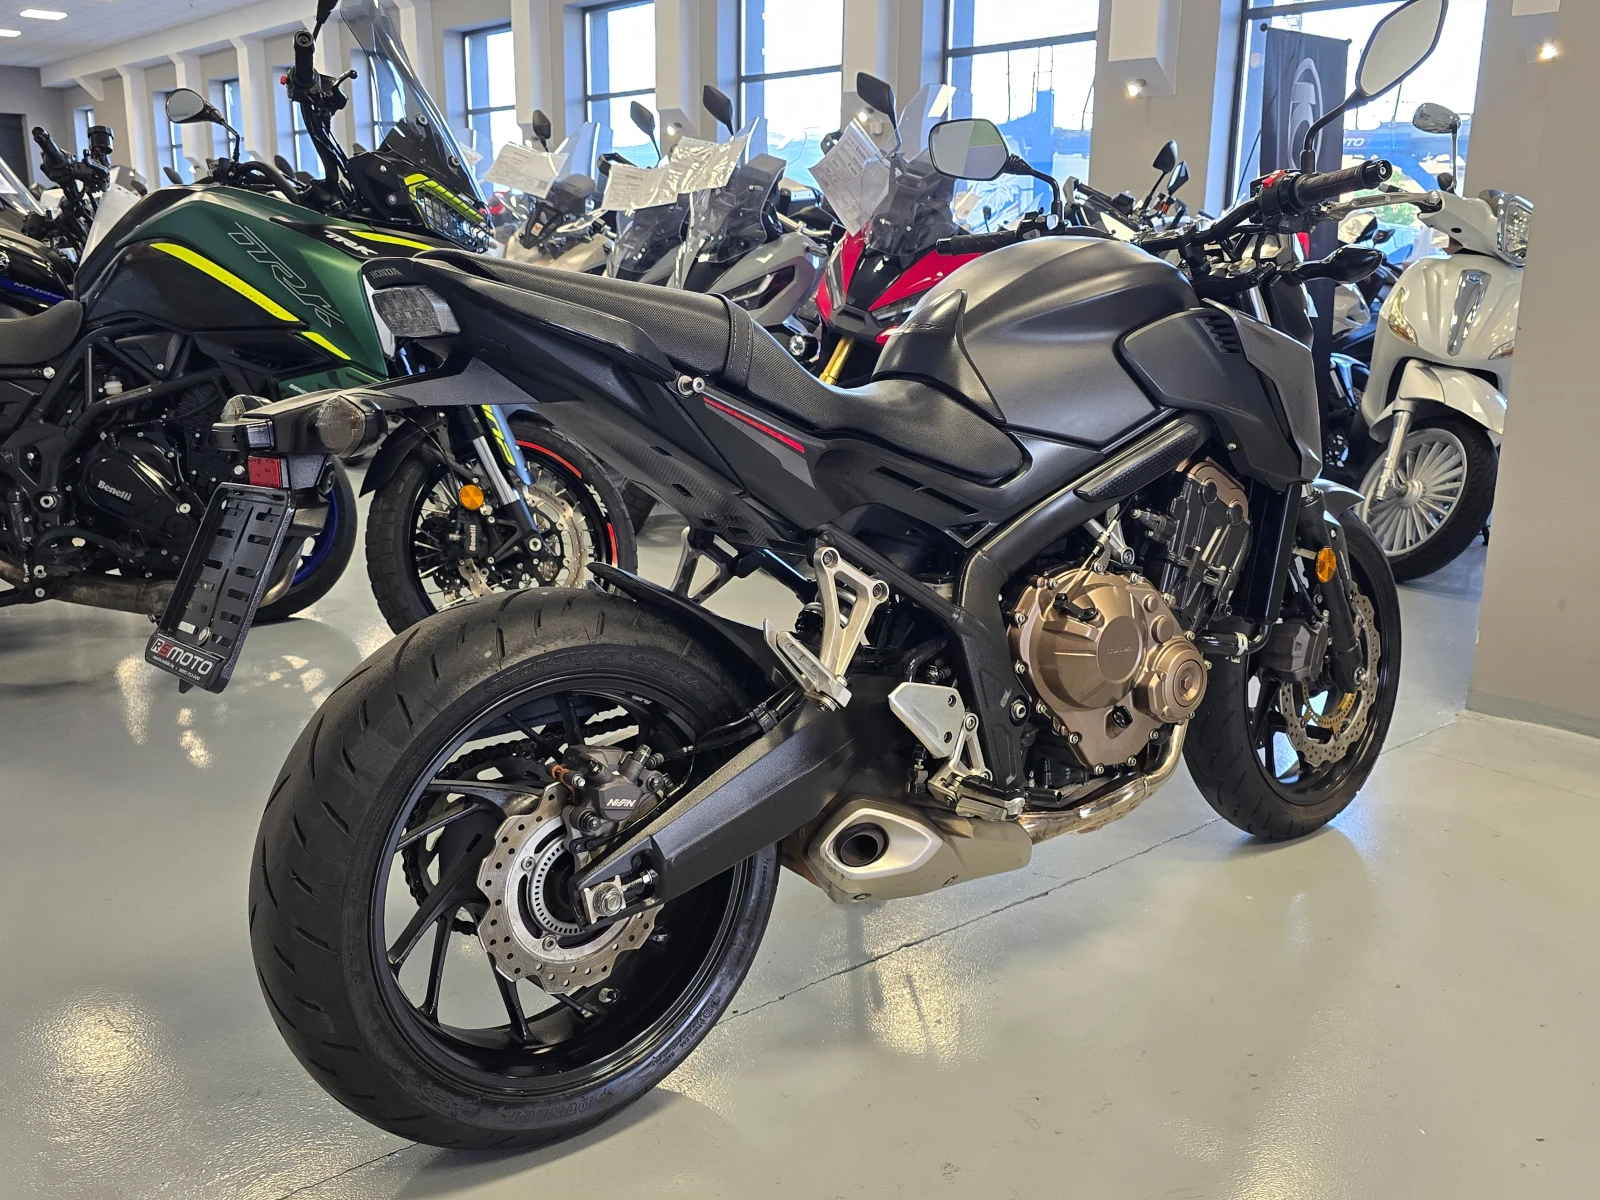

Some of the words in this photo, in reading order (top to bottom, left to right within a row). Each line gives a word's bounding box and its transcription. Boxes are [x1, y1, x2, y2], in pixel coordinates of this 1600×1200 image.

[324, 229, 379, 256] TRK
[228, 222, 345, 328] TRK
[369, 267, 402, 279] HONDA
[97, 479, 133, 502] Benelli
[469, 524, 477, 552] Benelli
[606, 798, 637, 808] NISSIN
[503, 1095, 594, 1124] DUNLOP
